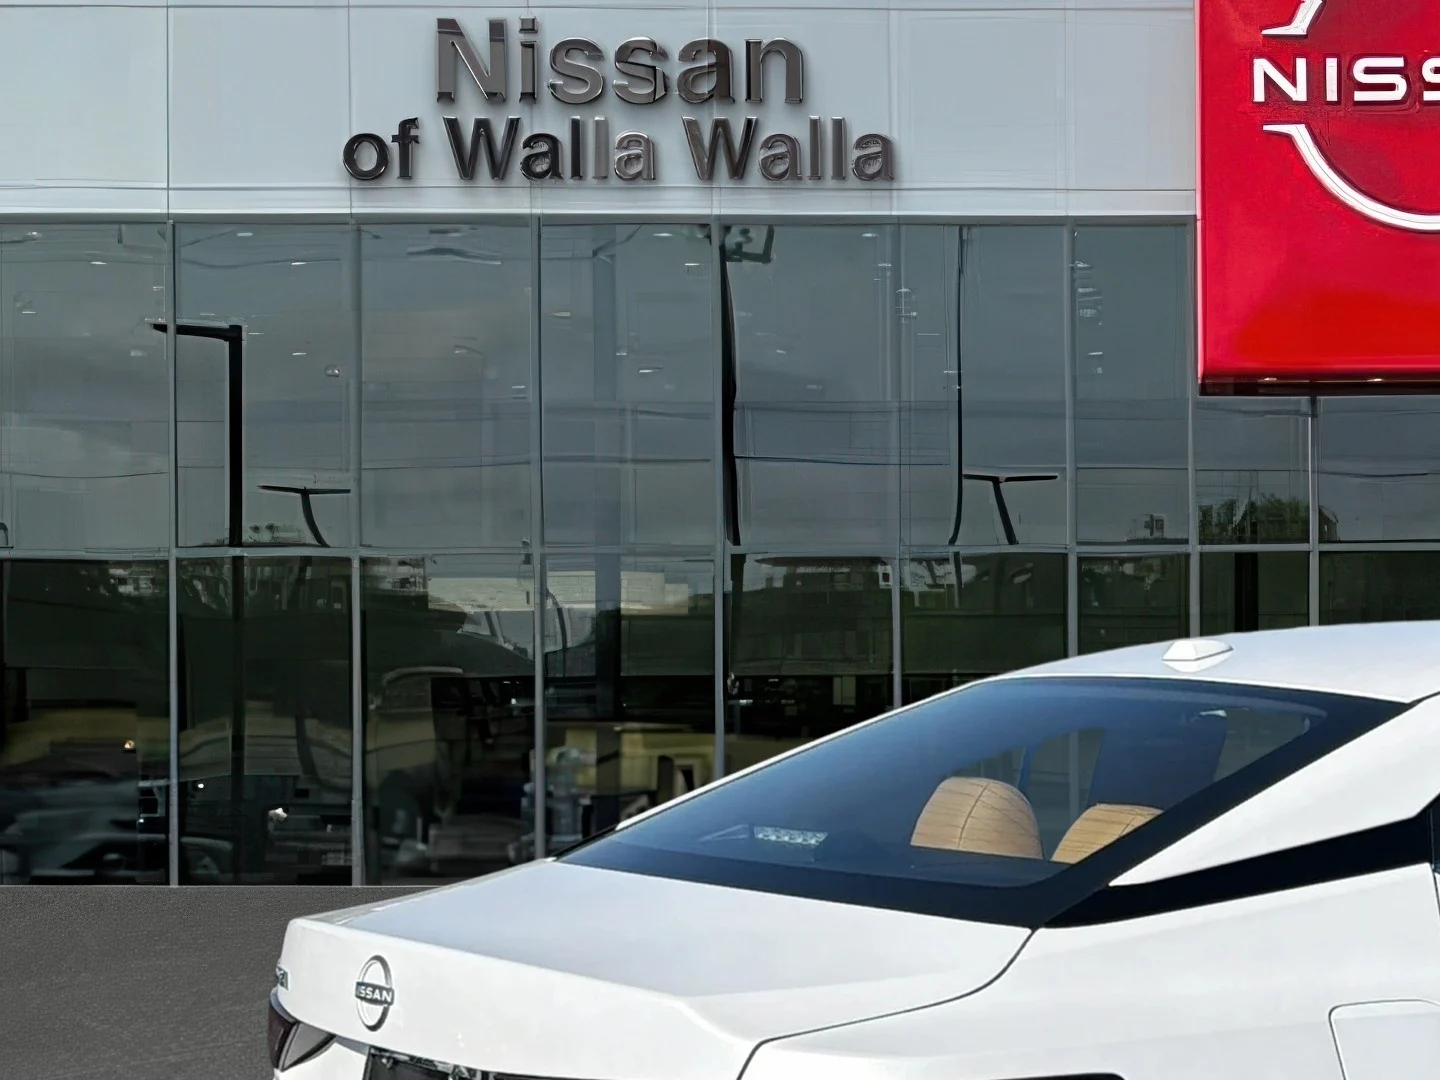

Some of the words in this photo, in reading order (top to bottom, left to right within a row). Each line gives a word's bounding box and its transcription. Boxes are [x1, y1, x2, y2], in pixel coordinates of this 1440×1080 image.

[435, 16, 804, 104] Nissan
[342, 116, 420, 181] of
[442, 115, 657, 181] Walla
[681, 115, 894, 181] Walla
